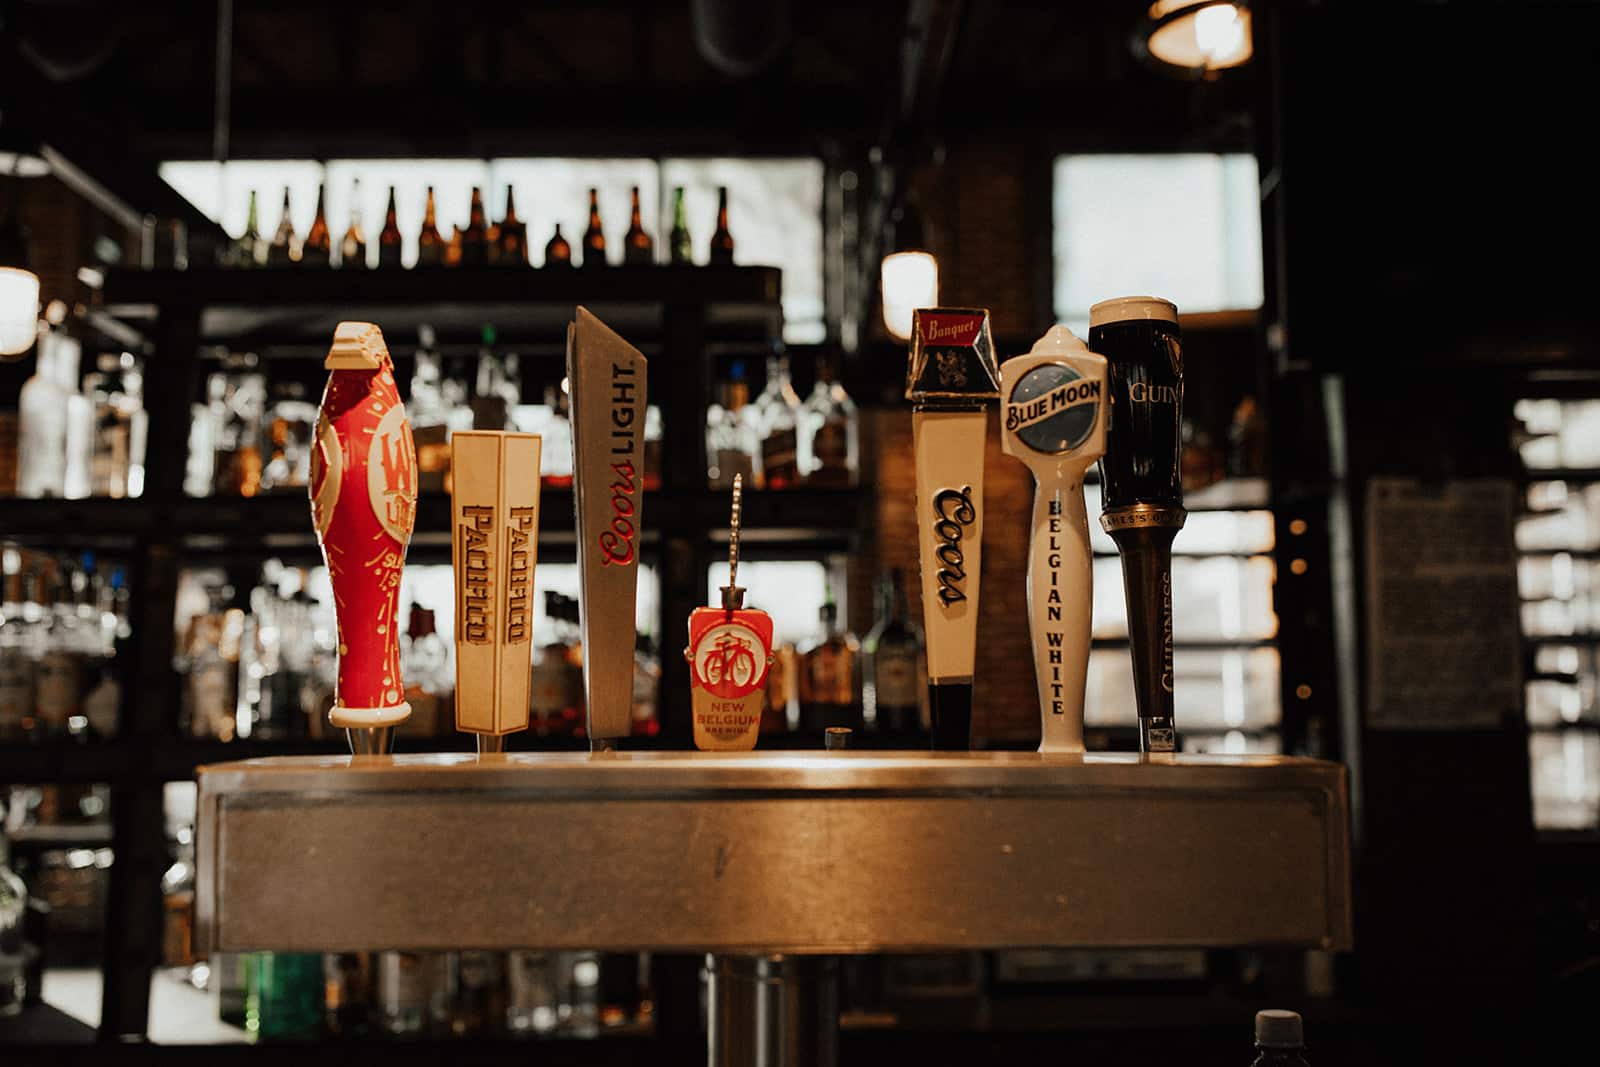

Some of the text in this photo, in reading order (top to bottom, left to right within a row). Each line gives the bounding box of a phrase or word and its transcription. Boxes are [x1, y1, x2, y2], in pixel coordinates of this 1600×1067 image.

[929, 319, 975, 341] Banquet
[600, 363, 635, 566] Coors LIGHT
[1006, 381, 1101, 431] BLUE MOON
[463, 505, 494, 644] PACIFICO
[508, 506, 534, 644] PACIFICO
[933, 485, 976, 608] Coors
[1047, 501, 1064, 715] BELGIAN WHITE
[696, 714, 759, 726] BELGIUM
[711, 703, 745, 712] NEW
